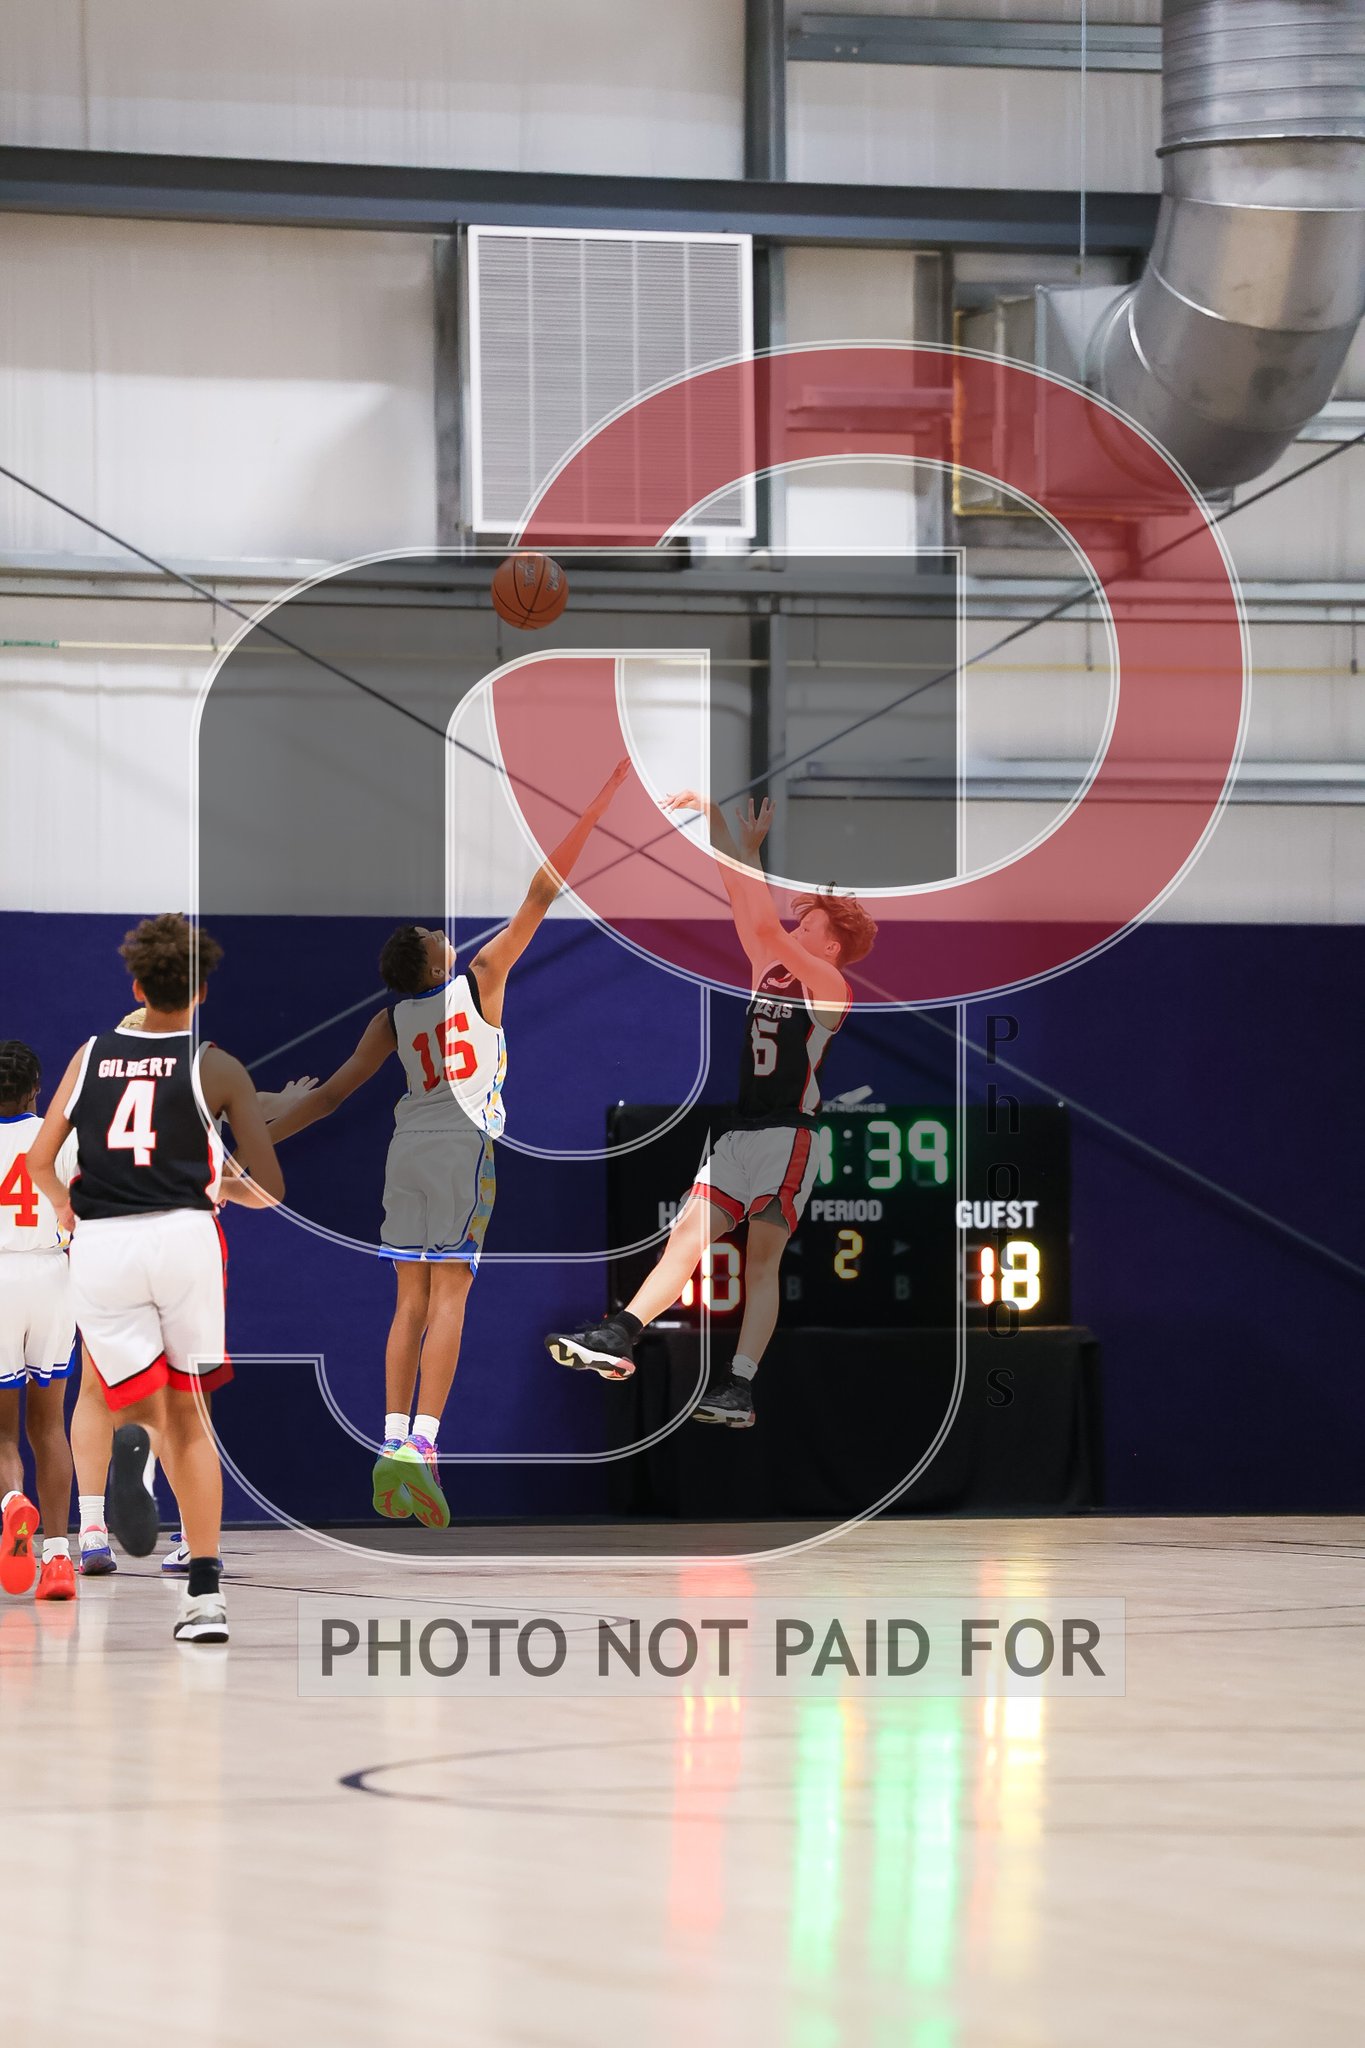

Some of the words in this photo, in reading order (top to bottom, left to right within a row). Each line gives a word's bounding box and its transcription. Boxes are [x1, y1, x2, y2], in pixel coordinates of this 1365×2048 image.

[98, 1057, 177, 1079] GILBERT
[412, 1012, 478, 1092] 15
[106, 1079, 157, 1168] 4
[0, 1153, 39, 1227] 4
[811, 1199, 883, 1222] PERIOD
[955, 1200, 1039, 1230] GUEST
[833, 1229, 863, 1280] 2
[979, 1240, 1041, 1311] 18
